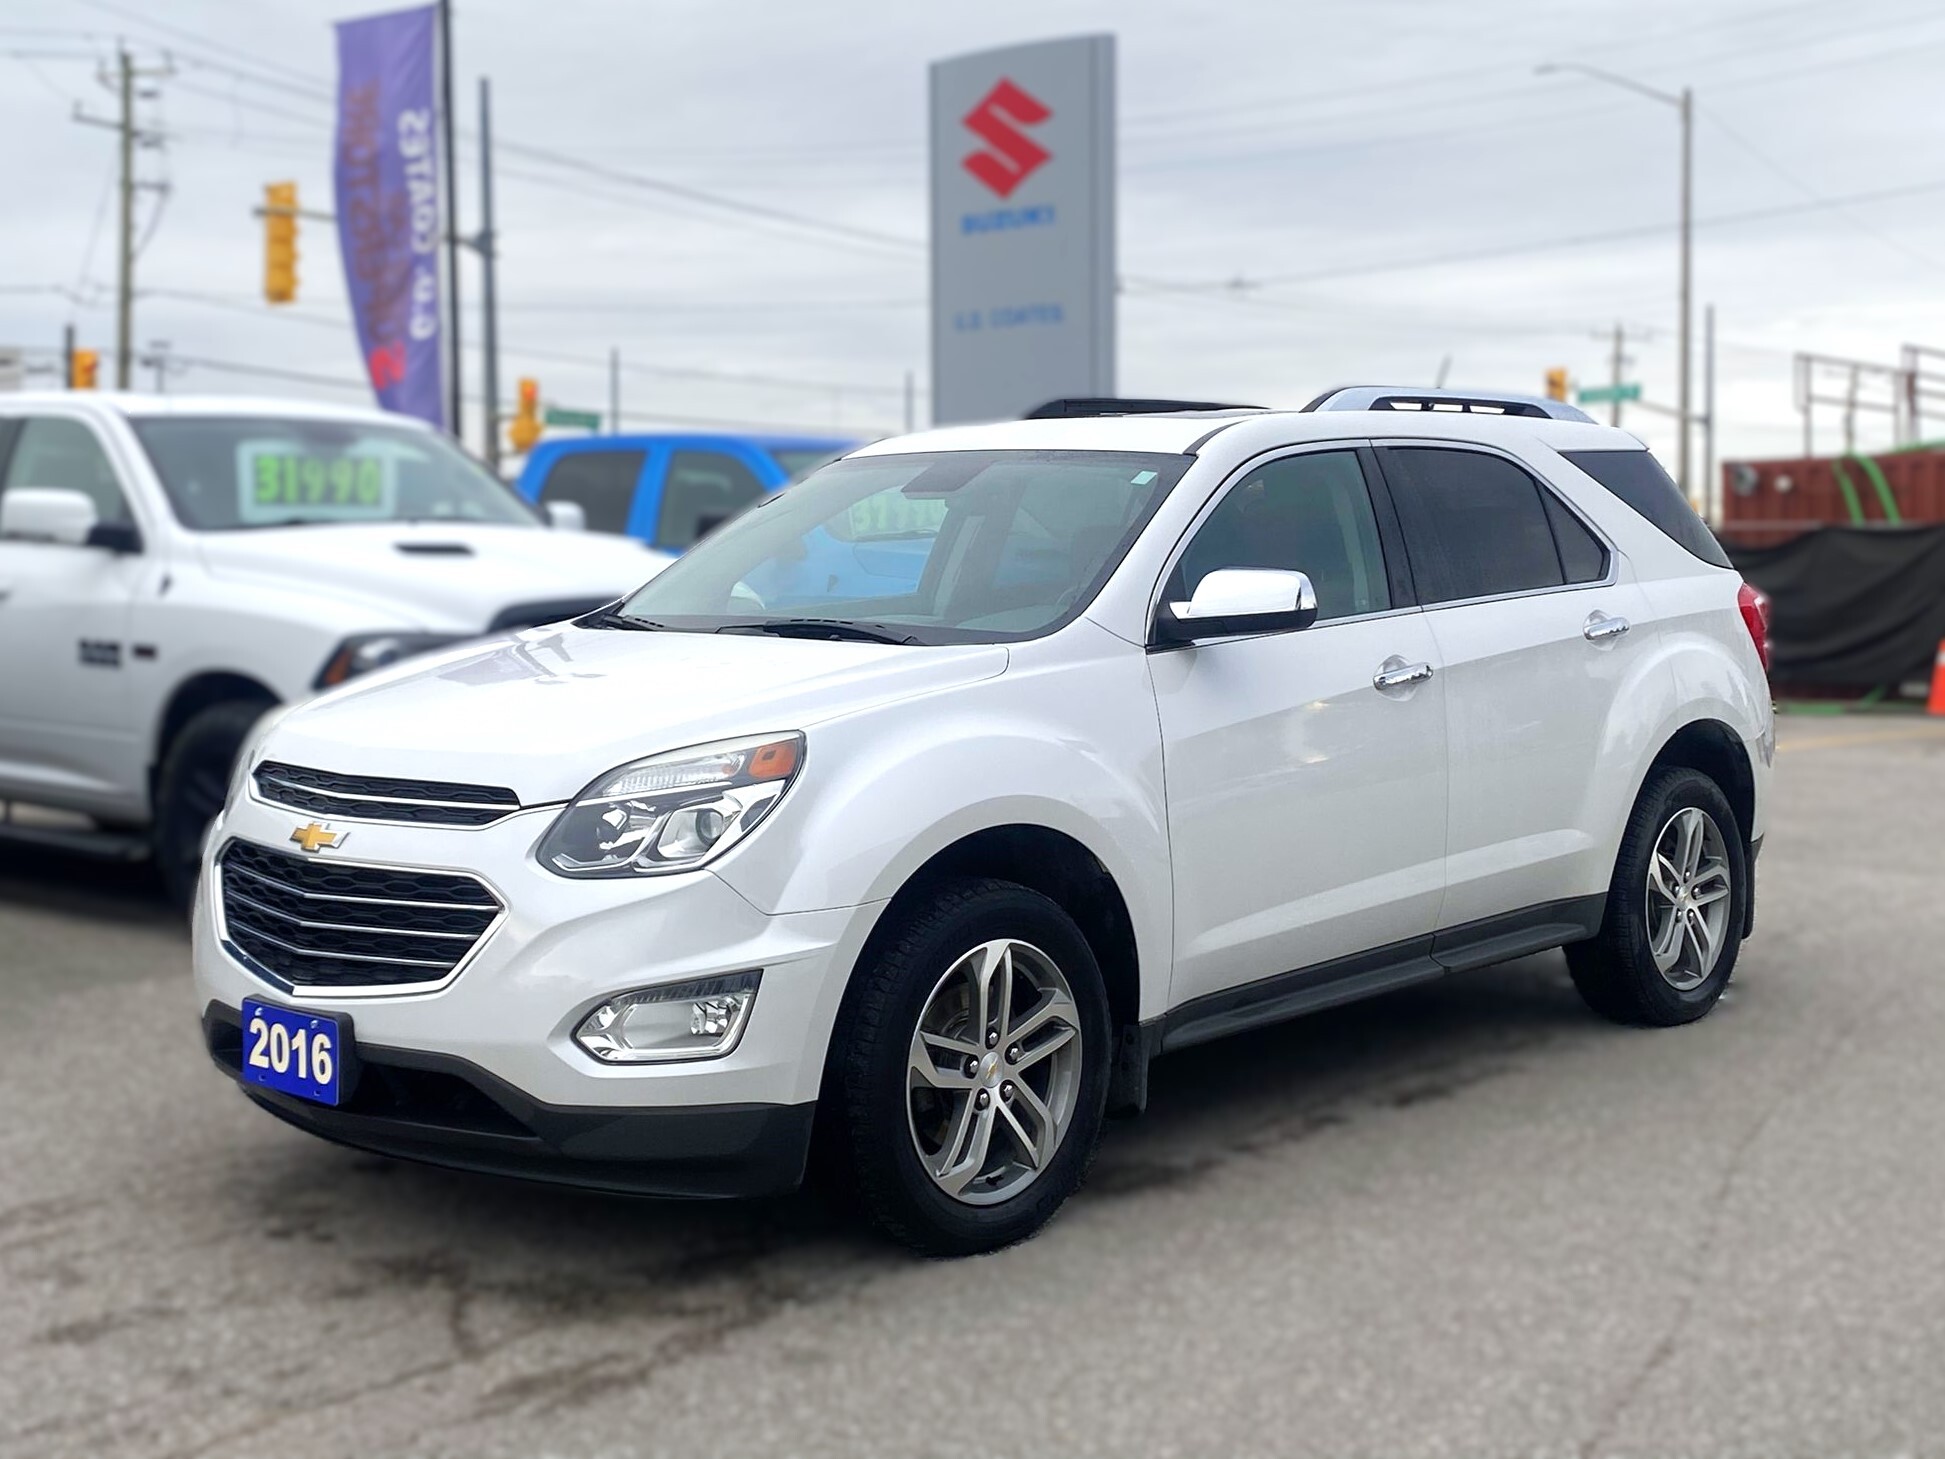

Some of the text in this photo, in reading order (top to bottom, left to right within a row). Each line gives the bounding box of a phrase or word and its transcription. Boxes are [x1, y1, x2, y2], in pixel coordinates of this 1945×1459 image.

[961, 204, 1056, 235] SUZUKI
[256, 454, 379, 503] 31990
[249, 1017, 333, 1085] 2016
